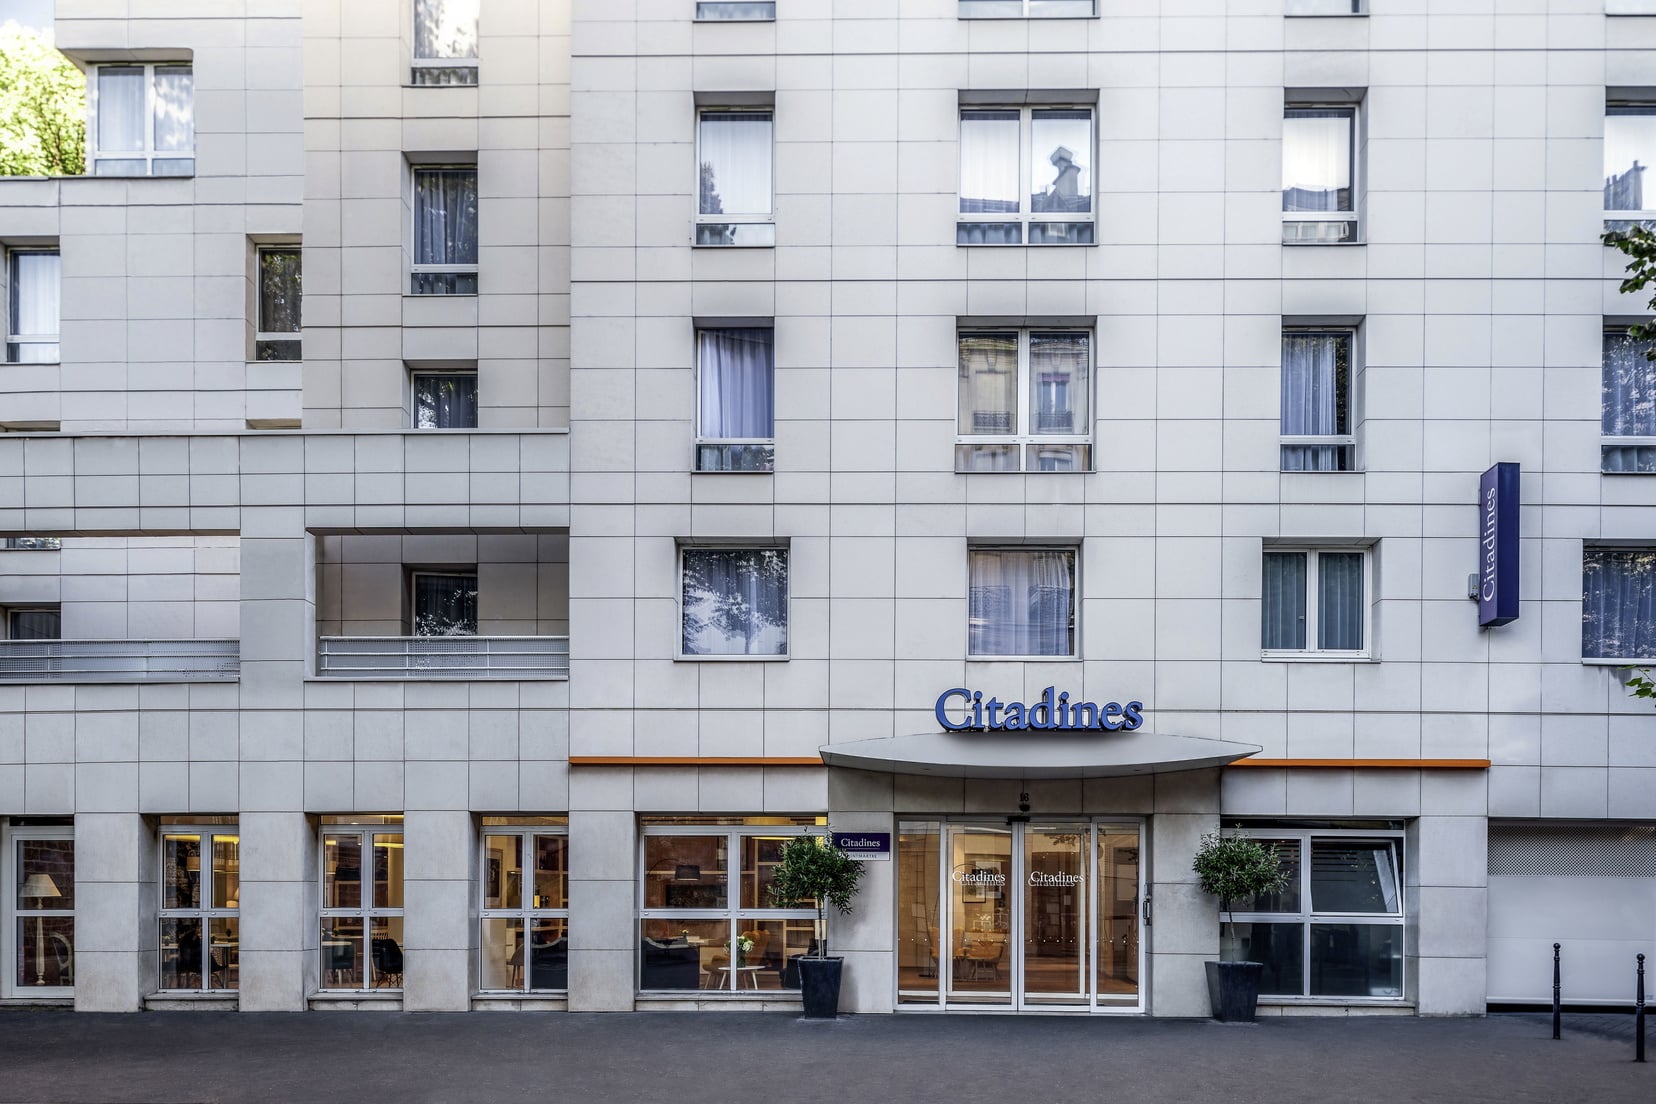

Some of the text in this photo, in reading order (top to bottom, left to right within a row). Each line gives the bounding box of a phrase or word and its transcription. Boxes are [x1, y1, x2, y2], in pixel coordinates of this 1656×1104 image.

[1483, 487, 1495, 602] Citadines
[935, 686, 1144, 731] Citadines
[841, 838, 880, 847] Citadines
[952, 870, 1006, 882] Citadines
[1030, 870, 1085, 883] Citadines
